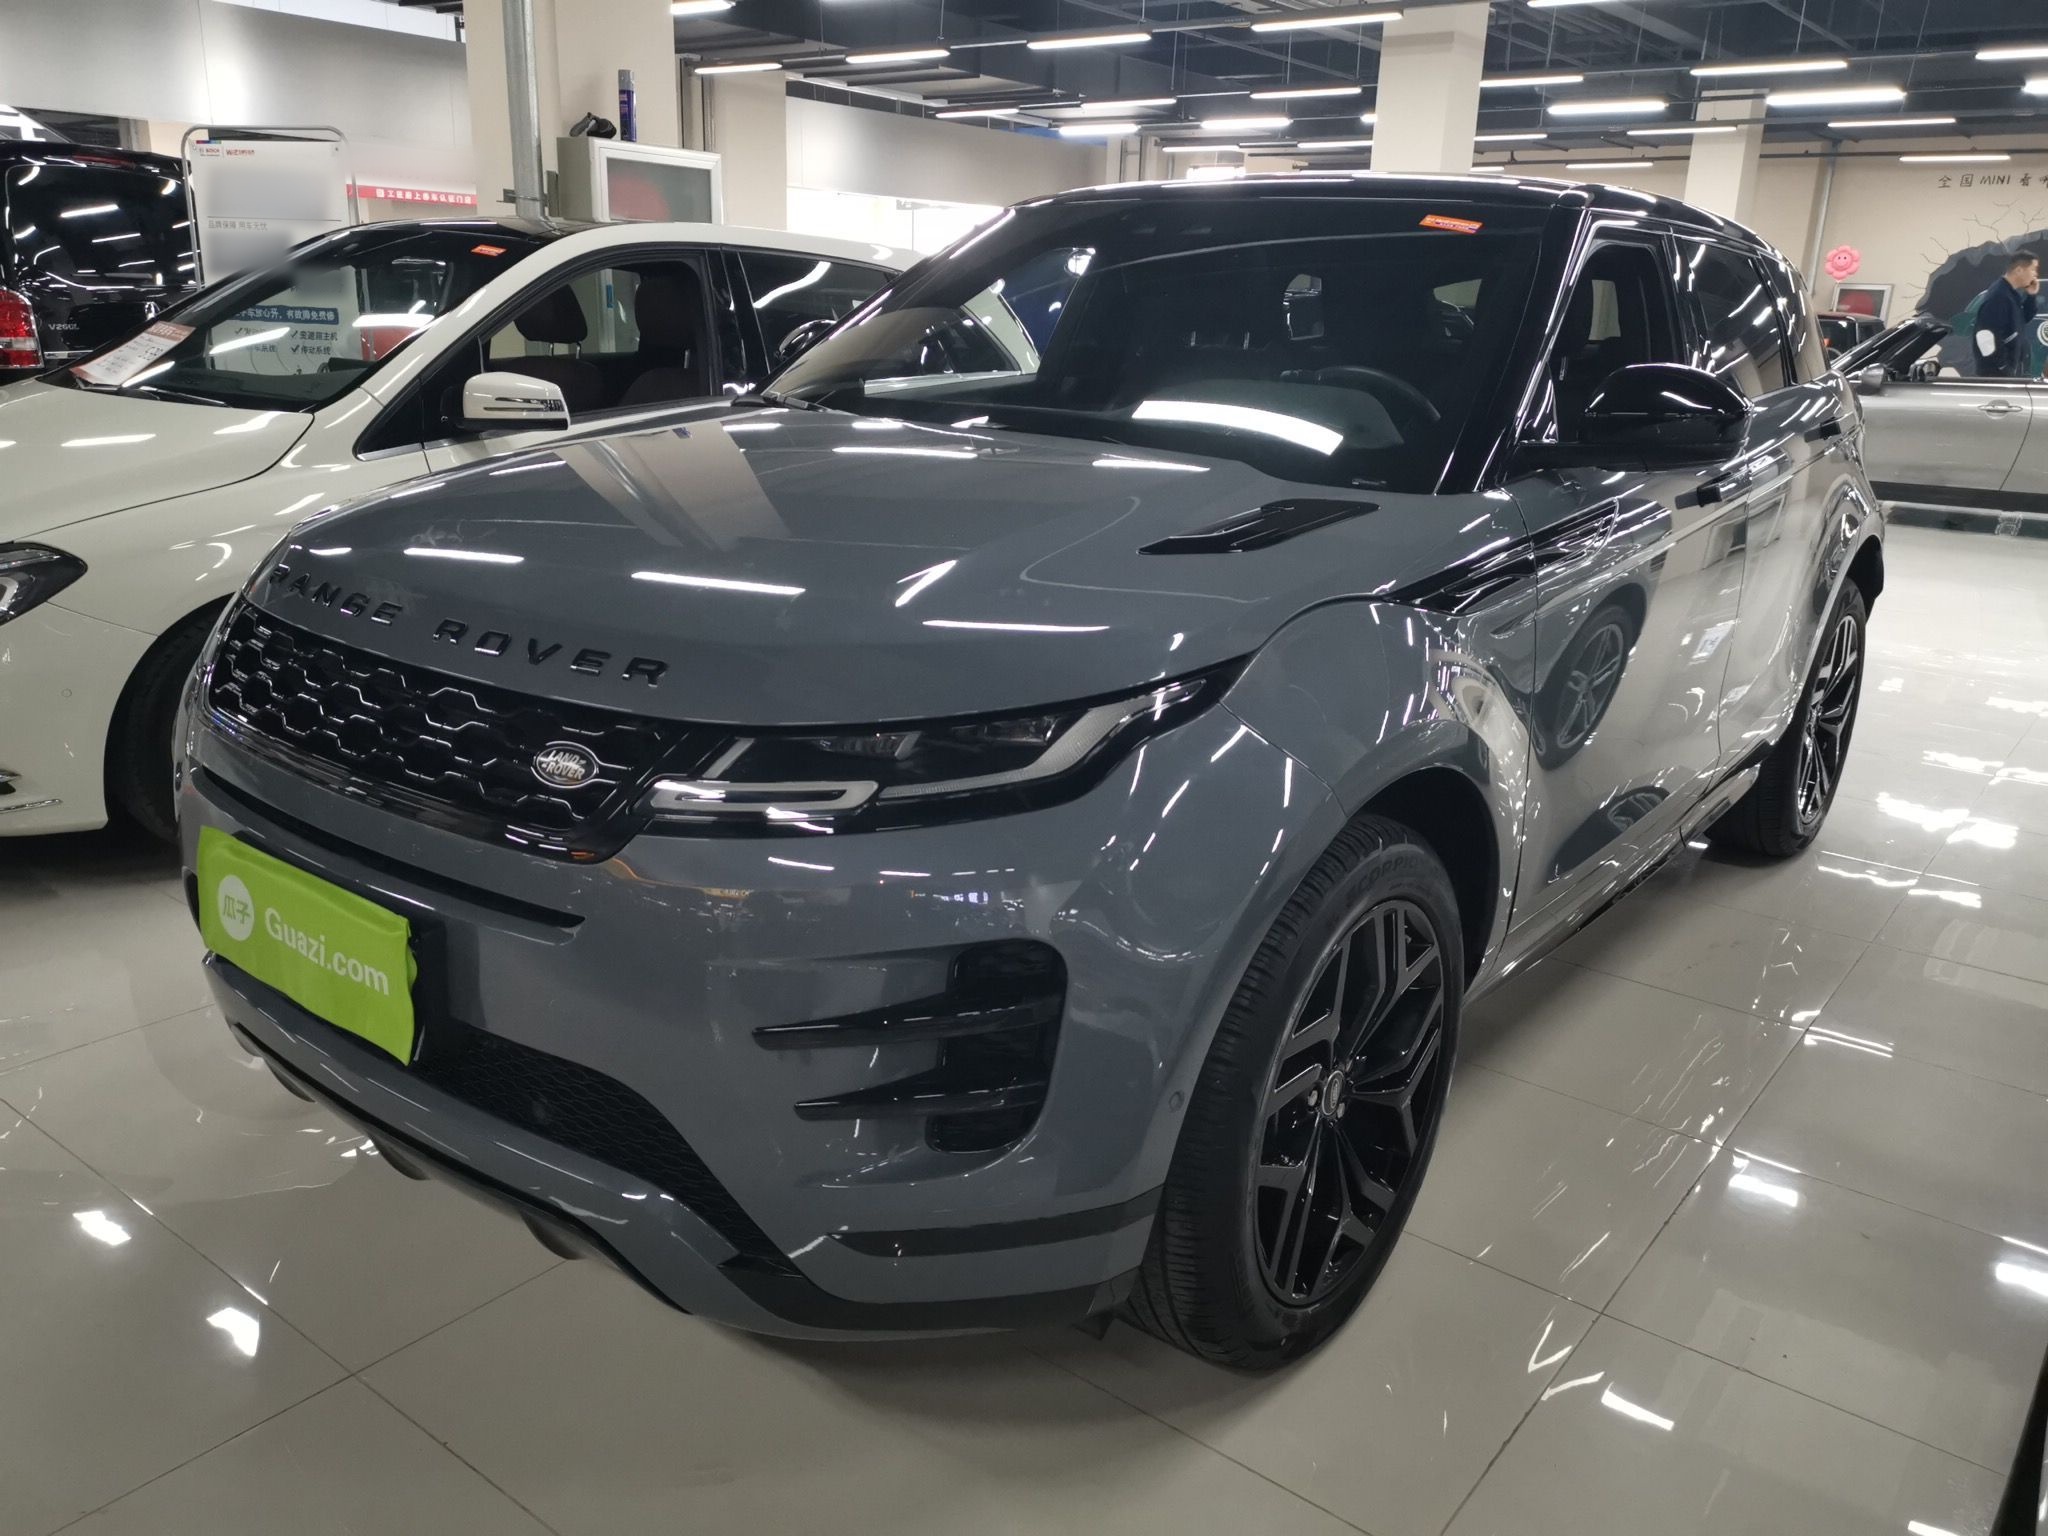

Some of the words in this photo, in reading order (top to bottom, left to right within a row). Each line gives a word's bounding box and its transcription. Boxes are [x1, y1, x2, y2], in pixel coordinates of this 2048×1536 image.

[270, 563, 403, 625] RANGE
[431, 618, 669, 689] ROVER
[546, 762, 586, 780] ROVER
[547, 750, 580, 765] LAND
[223, 894, 251, 925] 瓜子
[264, 906, 390, 996] Guazi.com
